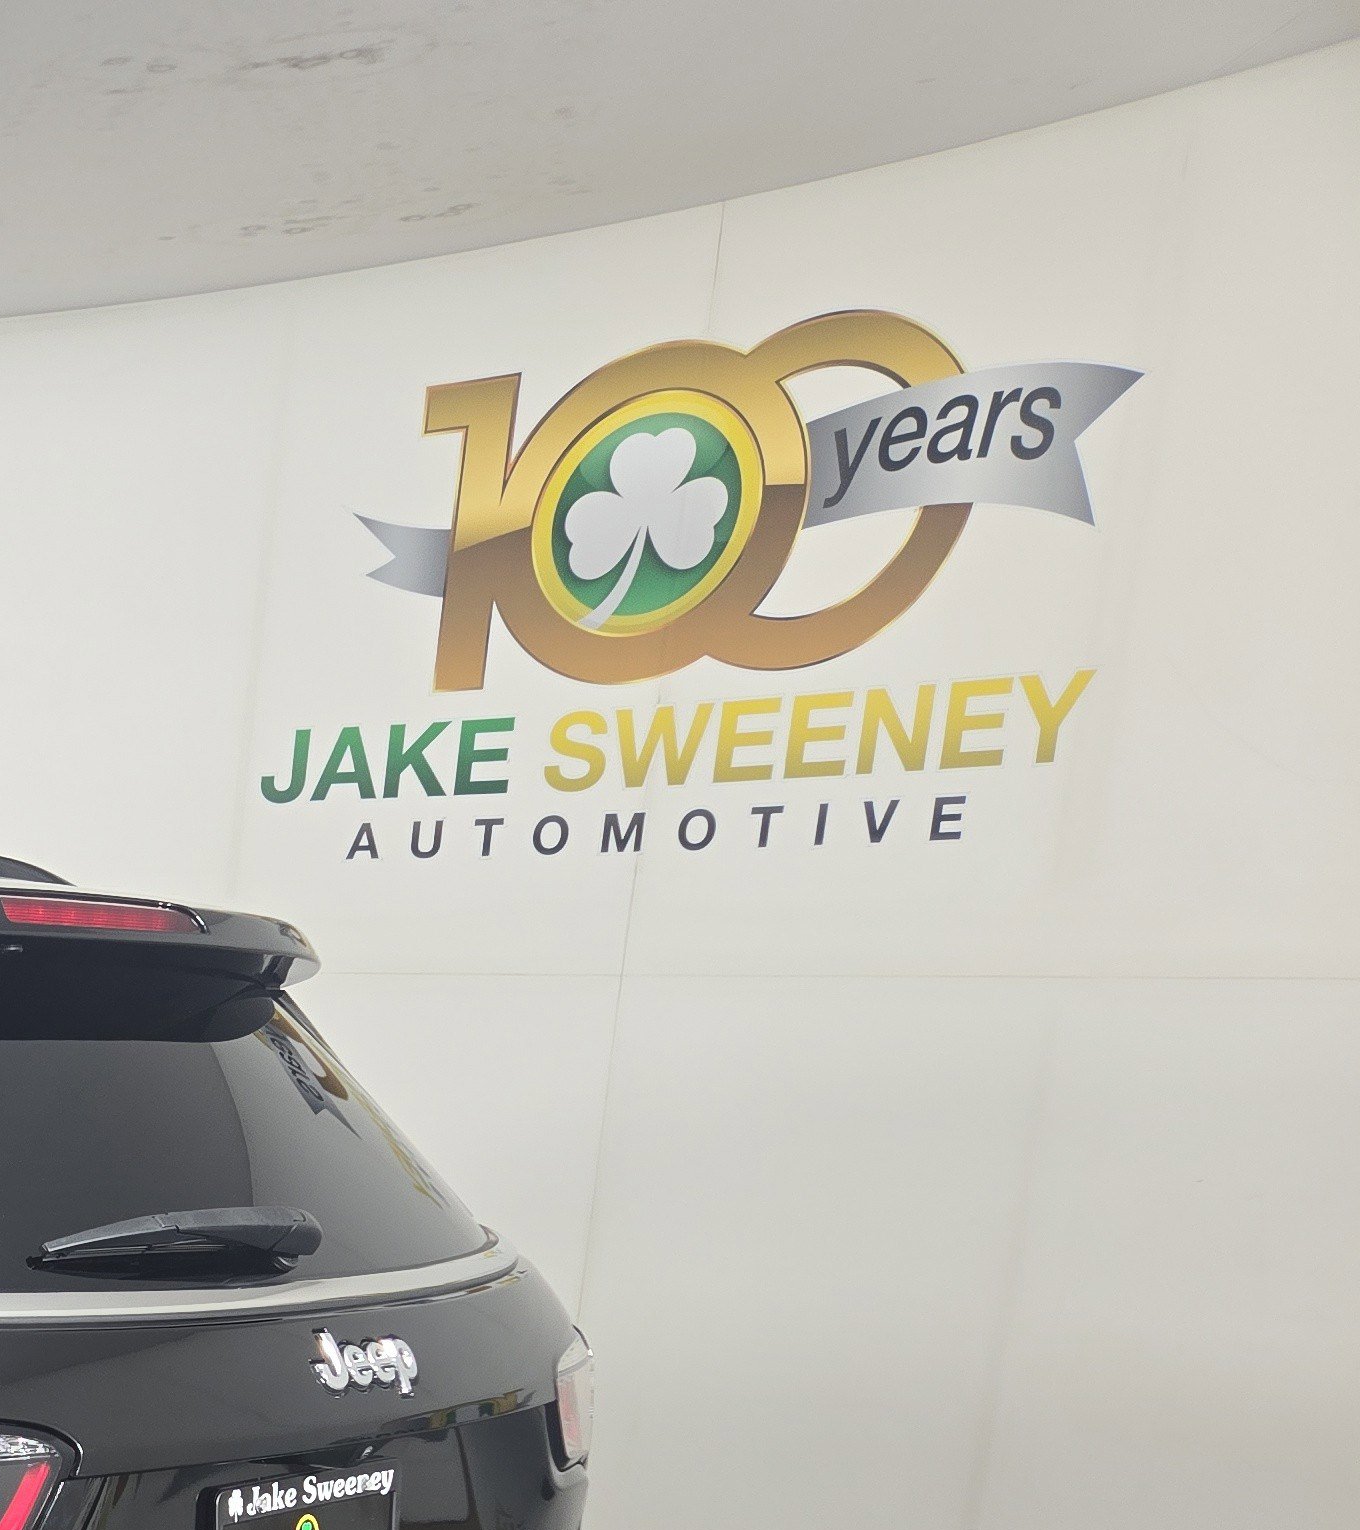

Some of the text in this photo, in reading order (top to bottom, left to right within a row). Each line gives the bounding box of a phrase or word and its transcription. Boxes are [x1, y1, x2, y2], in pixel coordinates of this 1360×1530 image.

[822, 385, 1062, 510] years
[261, 669, 1097, 804] JAKE SWEENEY
[346, 795, 969, 861] AUTOMOTIVE
[309, 1328, 418, 1398] Jeep
[246, 1481, 297, 1516] Jake
